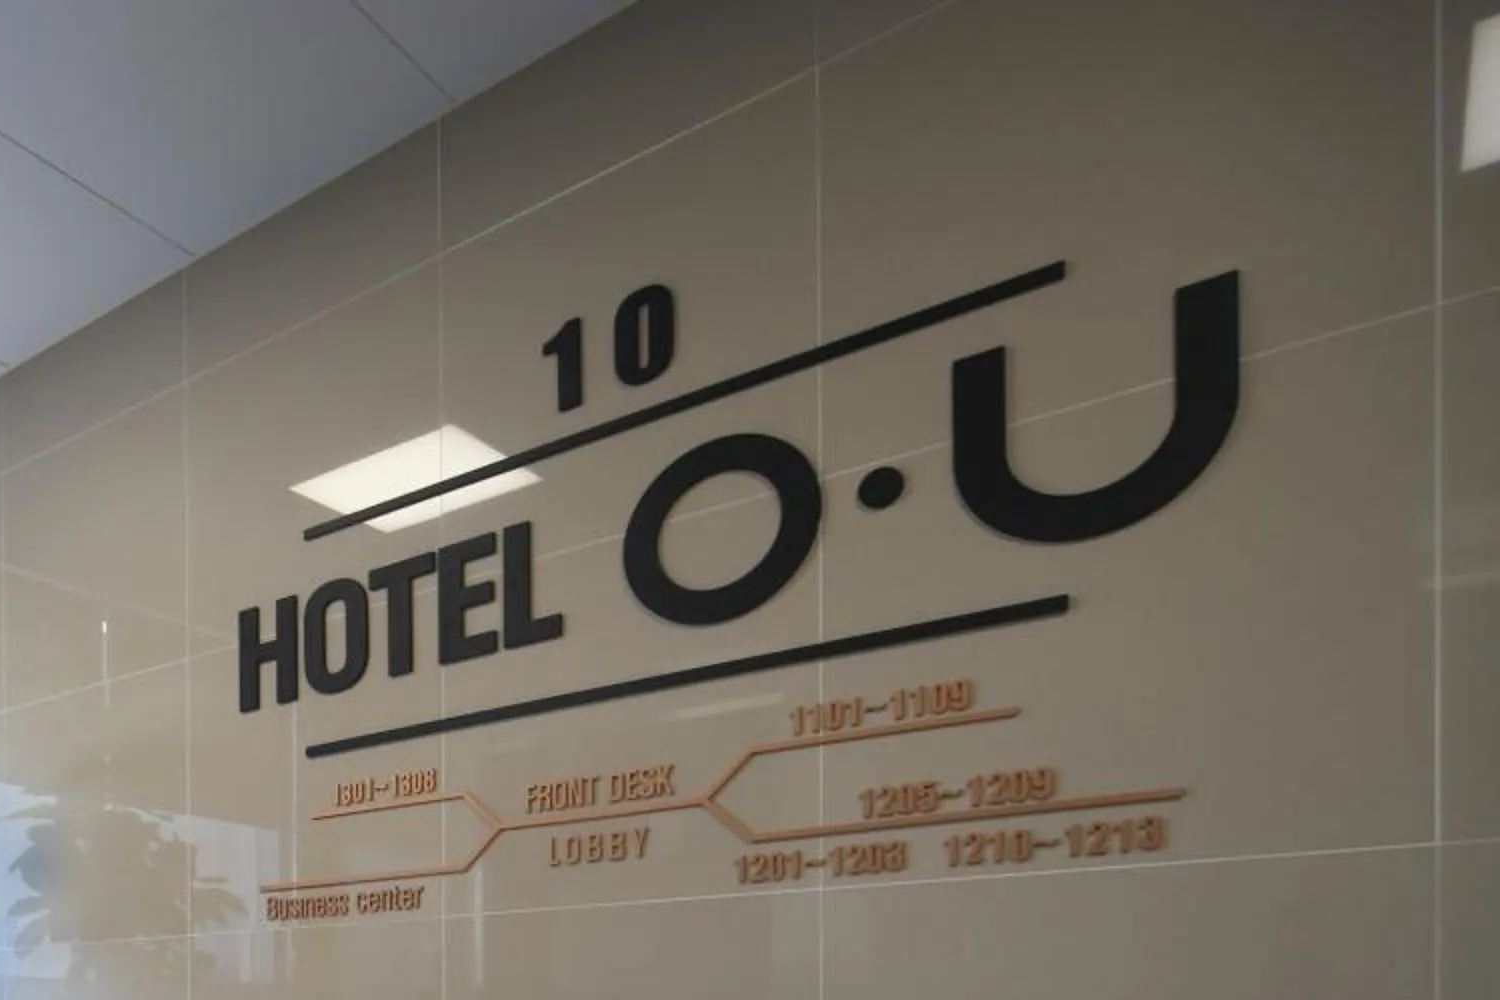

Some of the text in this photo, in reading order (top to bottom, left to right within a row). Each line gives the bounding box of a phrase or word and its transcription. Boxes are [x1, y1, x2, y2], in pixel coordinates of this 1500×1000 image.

[542, 283, 675, 412] 10
[237, 520, 564, 714] HOTEL
[525, 763, 675, 815] FRONT DESK
[548, 827, 650, 867] LOBBY
[356, 884, 425, 915] center
